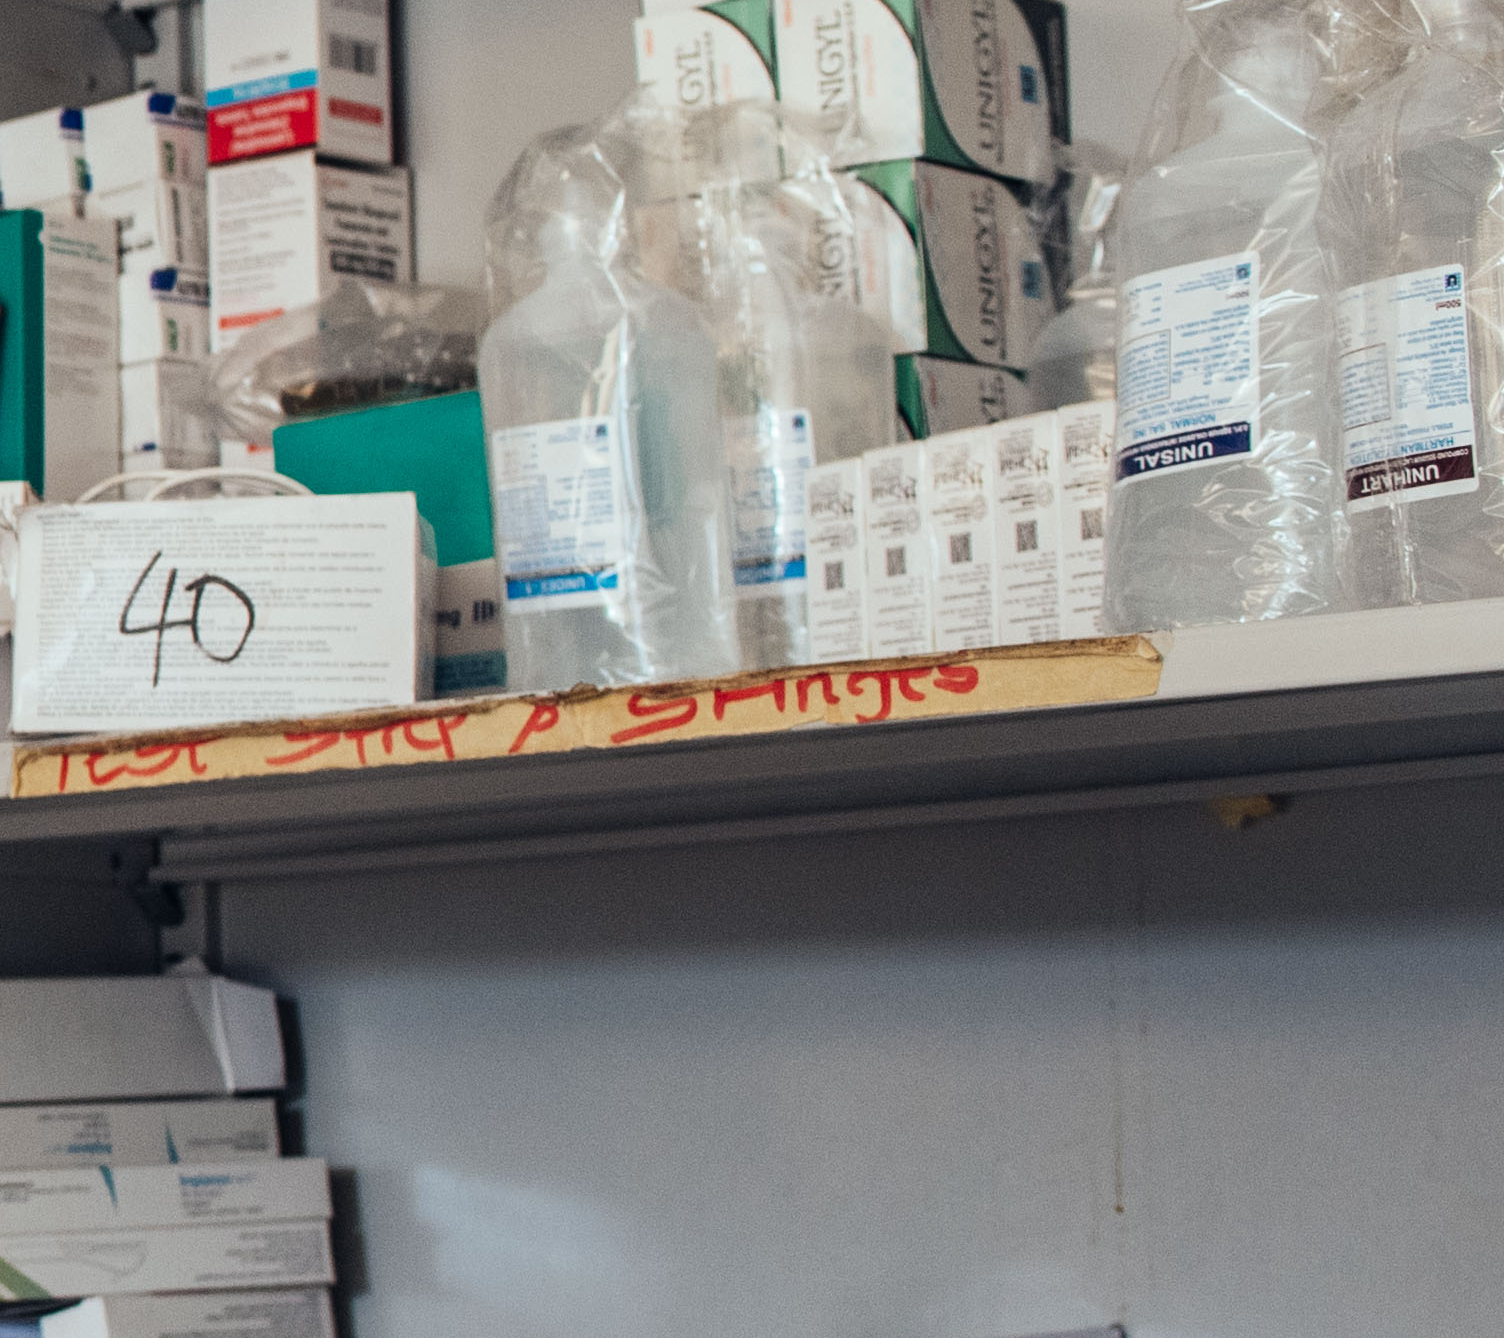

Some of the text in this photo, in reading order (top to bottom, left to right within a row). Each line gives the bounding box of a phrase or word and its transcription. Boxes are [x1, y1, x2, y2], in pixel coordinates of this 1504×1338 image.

[1133, 440, 1214, 470] UNISAL
[1360, 464, 1440, 493] UNIHART
[118, 549, 257, 689] 40
